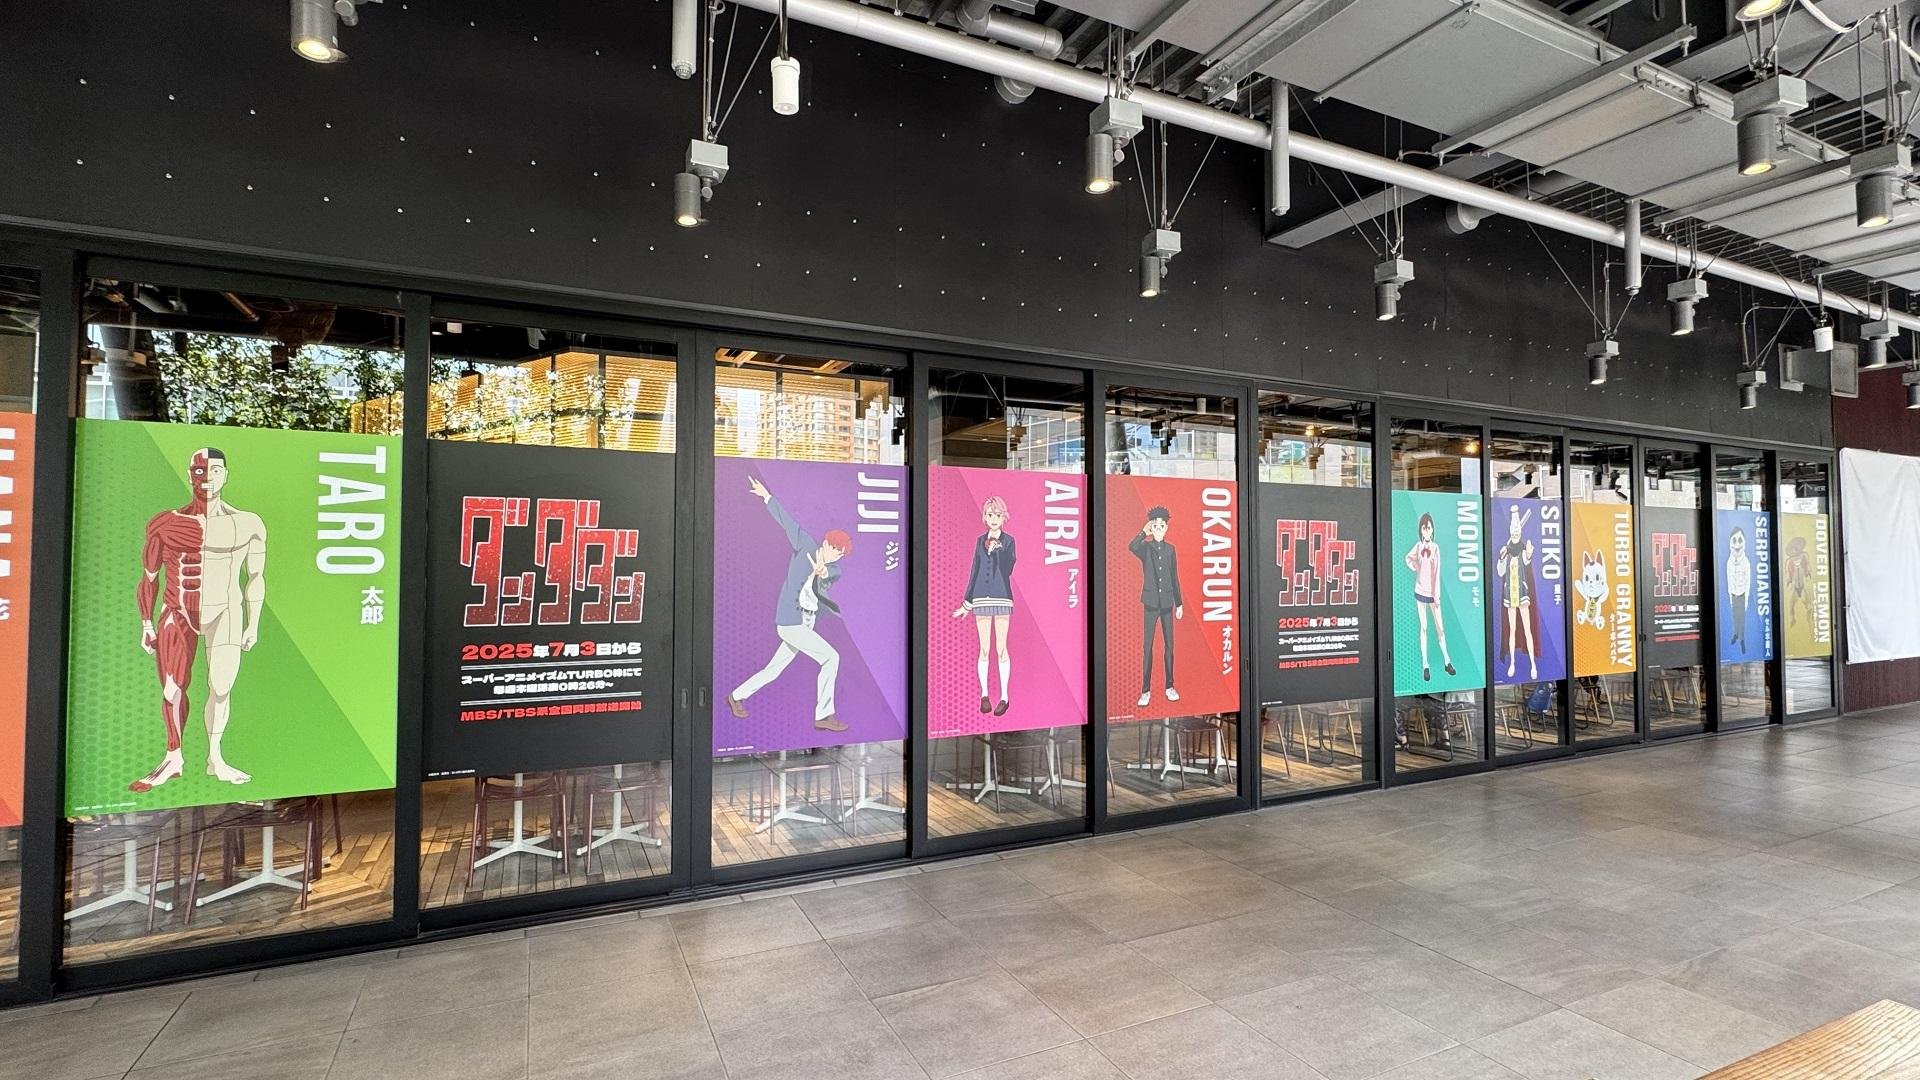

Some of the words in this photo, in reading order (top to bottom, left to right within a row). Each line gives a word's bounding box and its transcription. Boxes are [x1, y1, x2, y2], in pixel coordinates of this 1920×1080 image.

[316, 446, 386, 575] TARO
[858, 472, 899, 532] JIJI
[1044, 480, 1079, 565] AIRA
[885, 541, 899, 571] ジジ
[1201, 487, 1232, 621] OKARUN
[1457, 500, 1479, 583] MOMO
[1541, 505, 1561, 579] SEIKO
[1614, 511, 1631, 577] TURBO
[1755, 516, 1770, 616] SERPOIANS
[1816, 519, 1828, 576] DOVER
[361, 586, 384, 625] 太郎
[1068, 568, 1079, 608] アイラ
[1817, 581, 1830, 643] DEMON
[462, 641, 642, 660] 2025年7月3日から
[1222, 625, 1233, 675] オカルン
[1616, 584, 1632, 667] GRANNY
